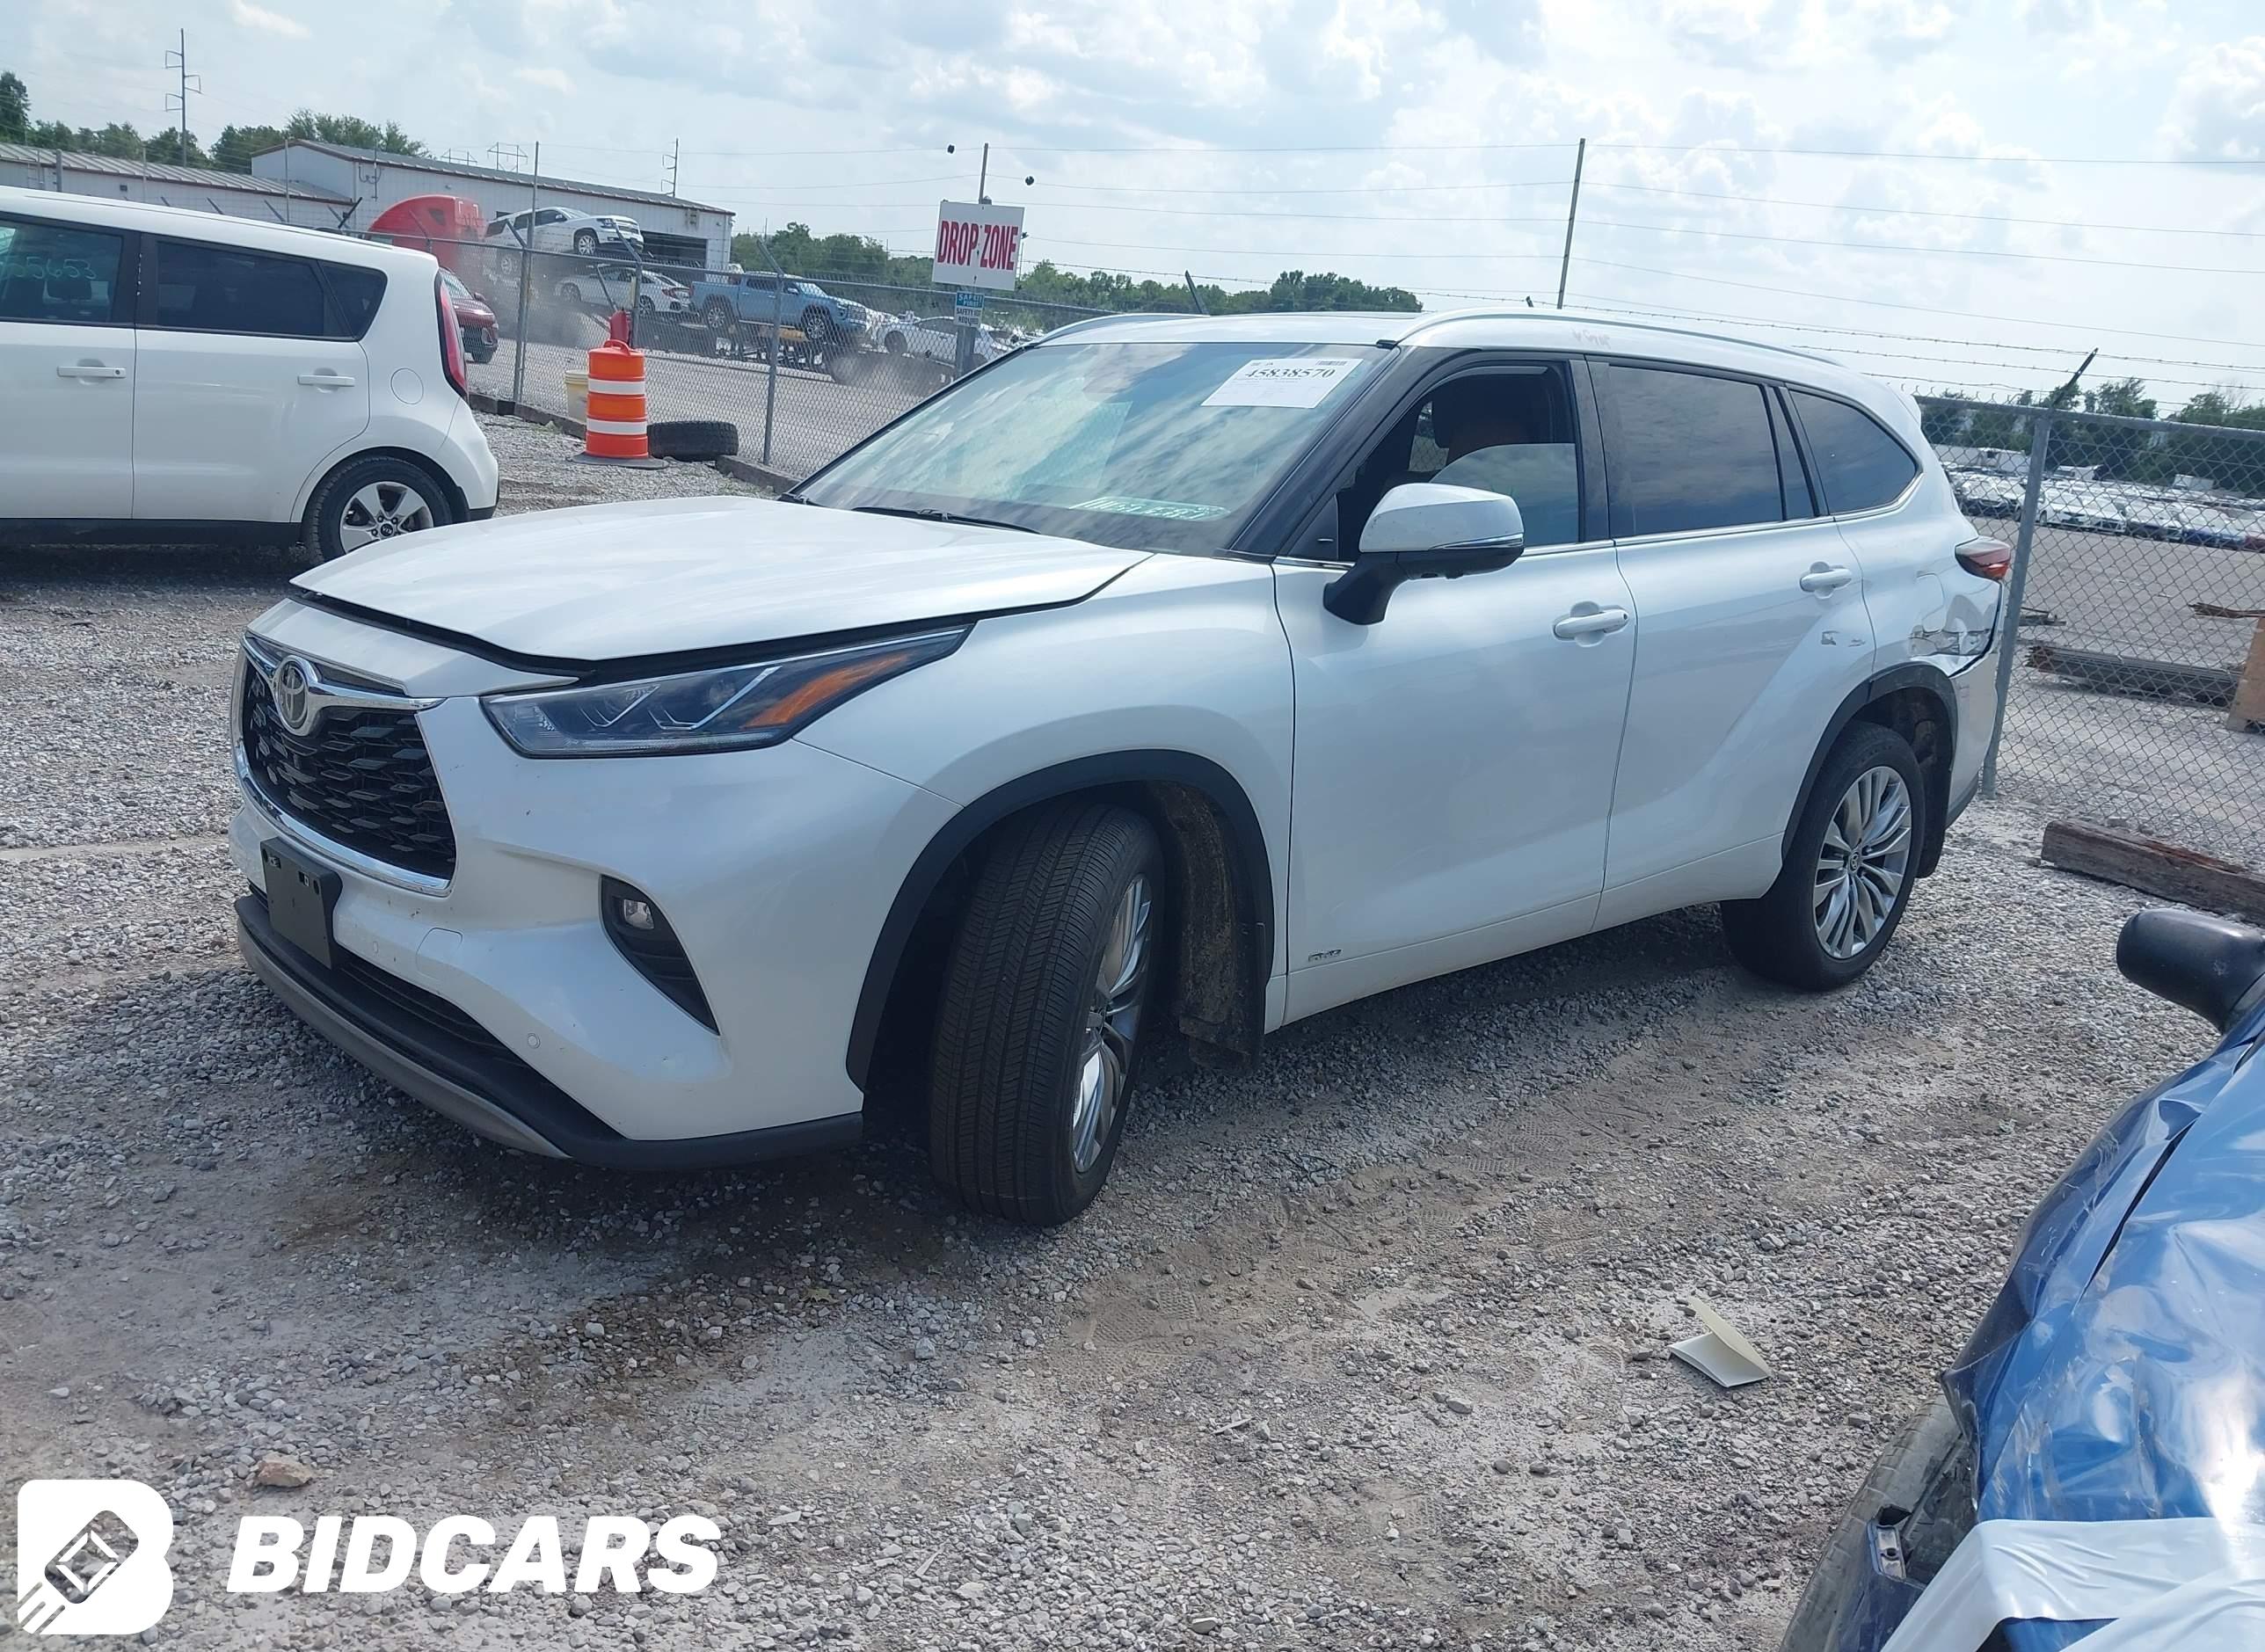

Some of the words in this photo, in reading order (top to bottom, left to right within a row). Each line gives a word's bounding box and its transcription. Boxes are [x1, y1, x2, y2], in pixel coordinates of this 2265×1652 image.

[937, 220, 980, 266] DROP
[980, 223, 1019, 271] ZONE
[958, 316, 979, 324] REQU
[1245, 368, 1336, 378] 45838570
